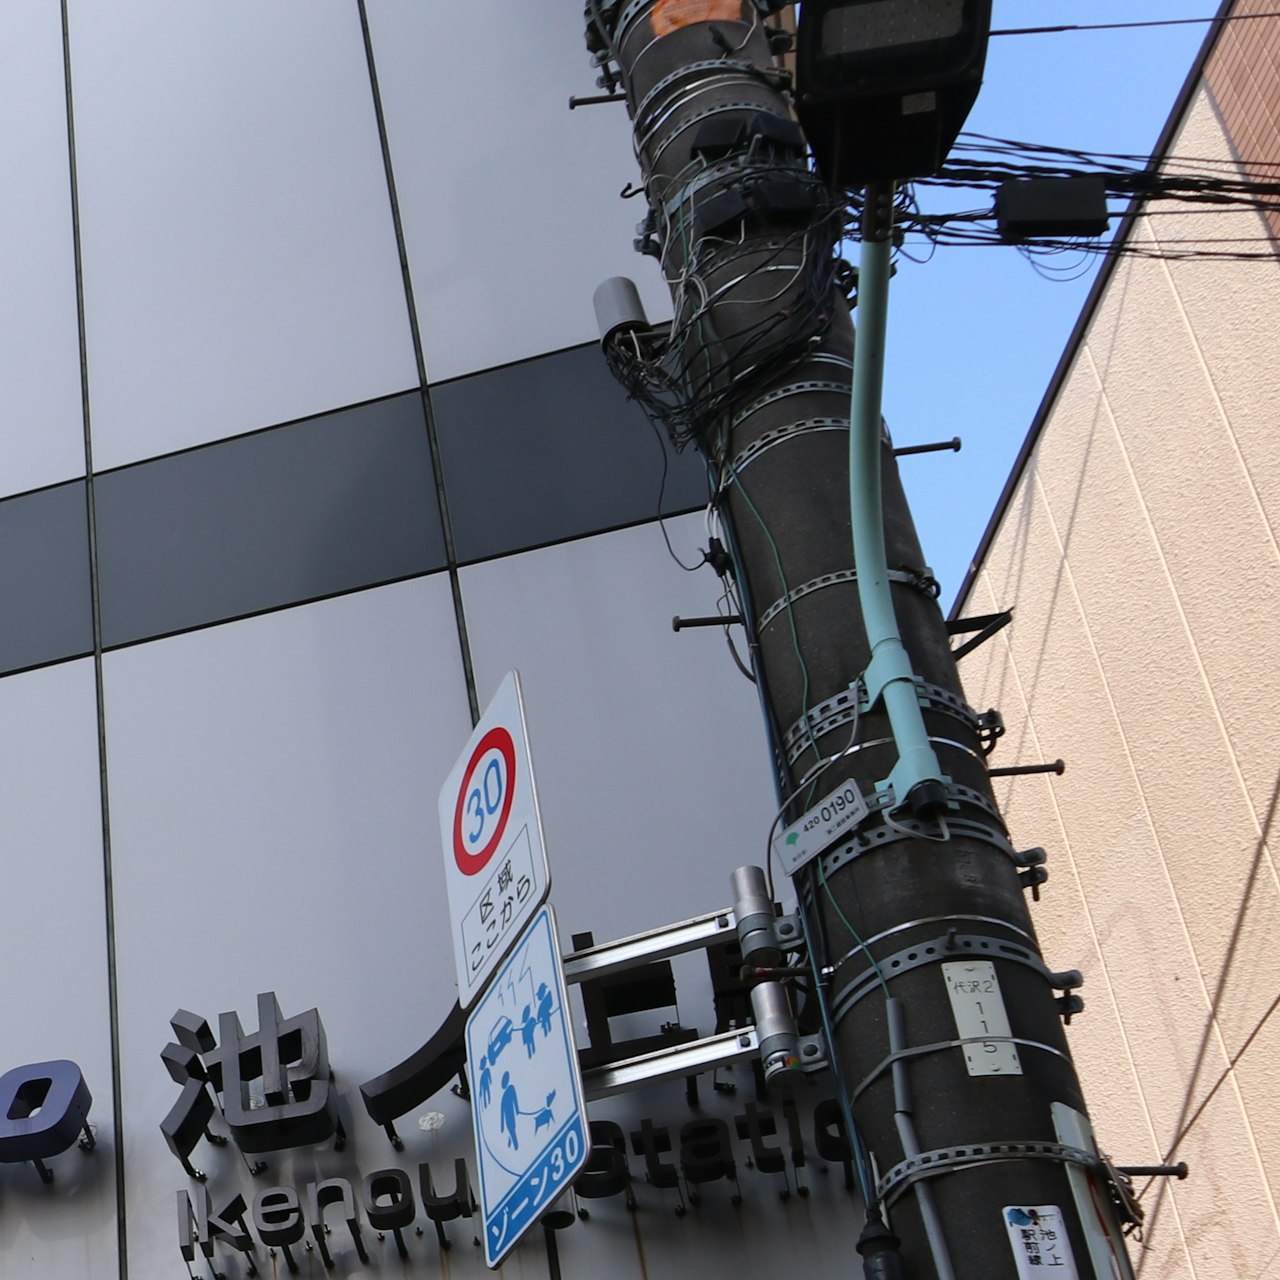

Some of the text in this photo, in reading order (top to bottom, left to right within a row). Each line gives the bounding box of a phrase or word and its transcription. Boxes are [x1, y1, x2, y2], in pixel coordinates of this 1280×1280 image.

[467, 758, 503, 844] 30
[803, 789, 855, 832] 420 0190
[469, 874, 531, 971] ここから
[478, 858, 514, 925] 区域
[953, 980, 995, 995] 代沢2
[176, 1156, 484, 1262] Ikenou
[490, 1128, 579, 1253] ゾーン30
